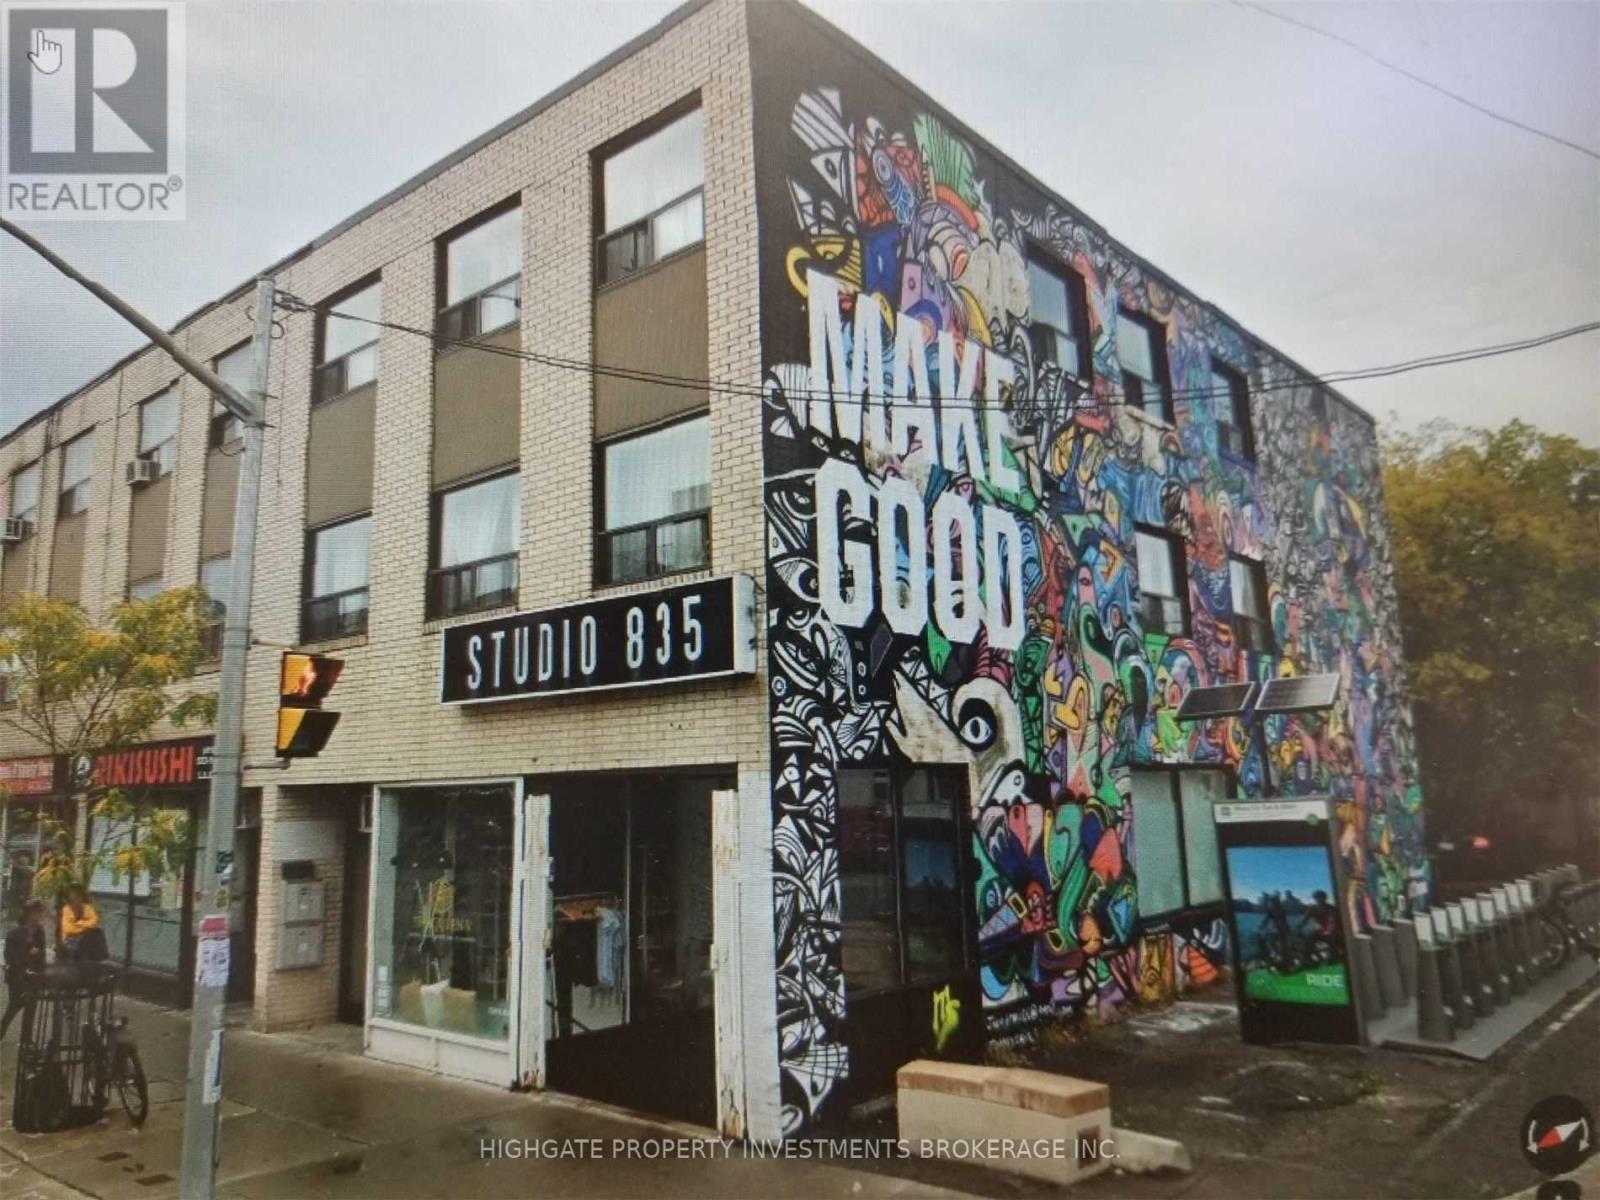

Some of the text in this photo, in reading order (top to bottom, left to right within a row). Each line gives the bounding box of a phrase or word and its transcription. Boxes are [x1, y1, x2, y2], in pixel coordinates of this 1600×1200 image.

[806, 267, 1024, 493] MAKE
[815, 457, 1026, 650] GOOD
[467, 595, 702, 690] STUDIO 835
[94, 746, 194, 786] RIKISUSHI
